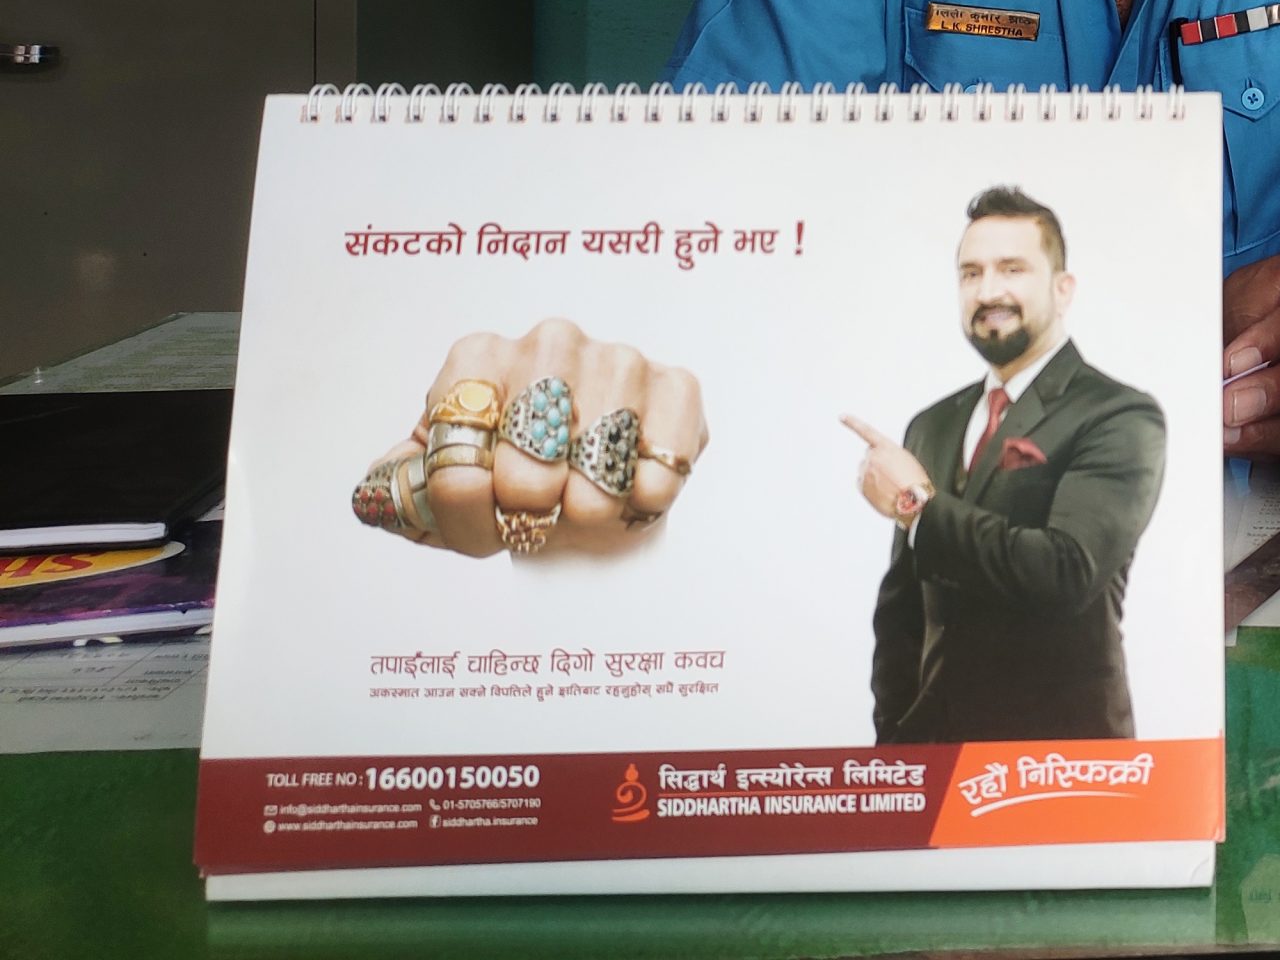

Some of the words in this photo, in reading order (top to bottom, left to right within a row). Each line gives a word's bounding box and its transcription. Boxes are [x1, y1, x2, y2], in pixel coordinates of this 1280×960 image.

[965, 23, 1023, 37] SHRESTHA
[345, 222, 467, 256] संकटको
[477, 222, 571, 260] निदान
[582, 221, 664, 254] यसरी
[675, 221, 723, 271] हुने
[468, 649, 542, 675] चाहिन्छ
[551, 648, 595, 676] दिगो
[604, 652, 664, 677] सुरक्षा
[674, 651, 726, 669] कवच
[536, 684, 554, 702] हुने
[266, 772, 299, 787] TOLL
[302, 772, 333, 787] FREE
[365, 765, 540, 790] 16600150050
[658, 764, 727, 791] सिद्धार्थ
[736, 763, 833, 790] इन्स्योरेन्स
[843, 759, 926, 786] लिमिटेड
[657, 797, 761, 817] SIDDHARTHA
[765, 795, 856, 814] INSURANCE
[861, 793, 926, 812] LIMITED
